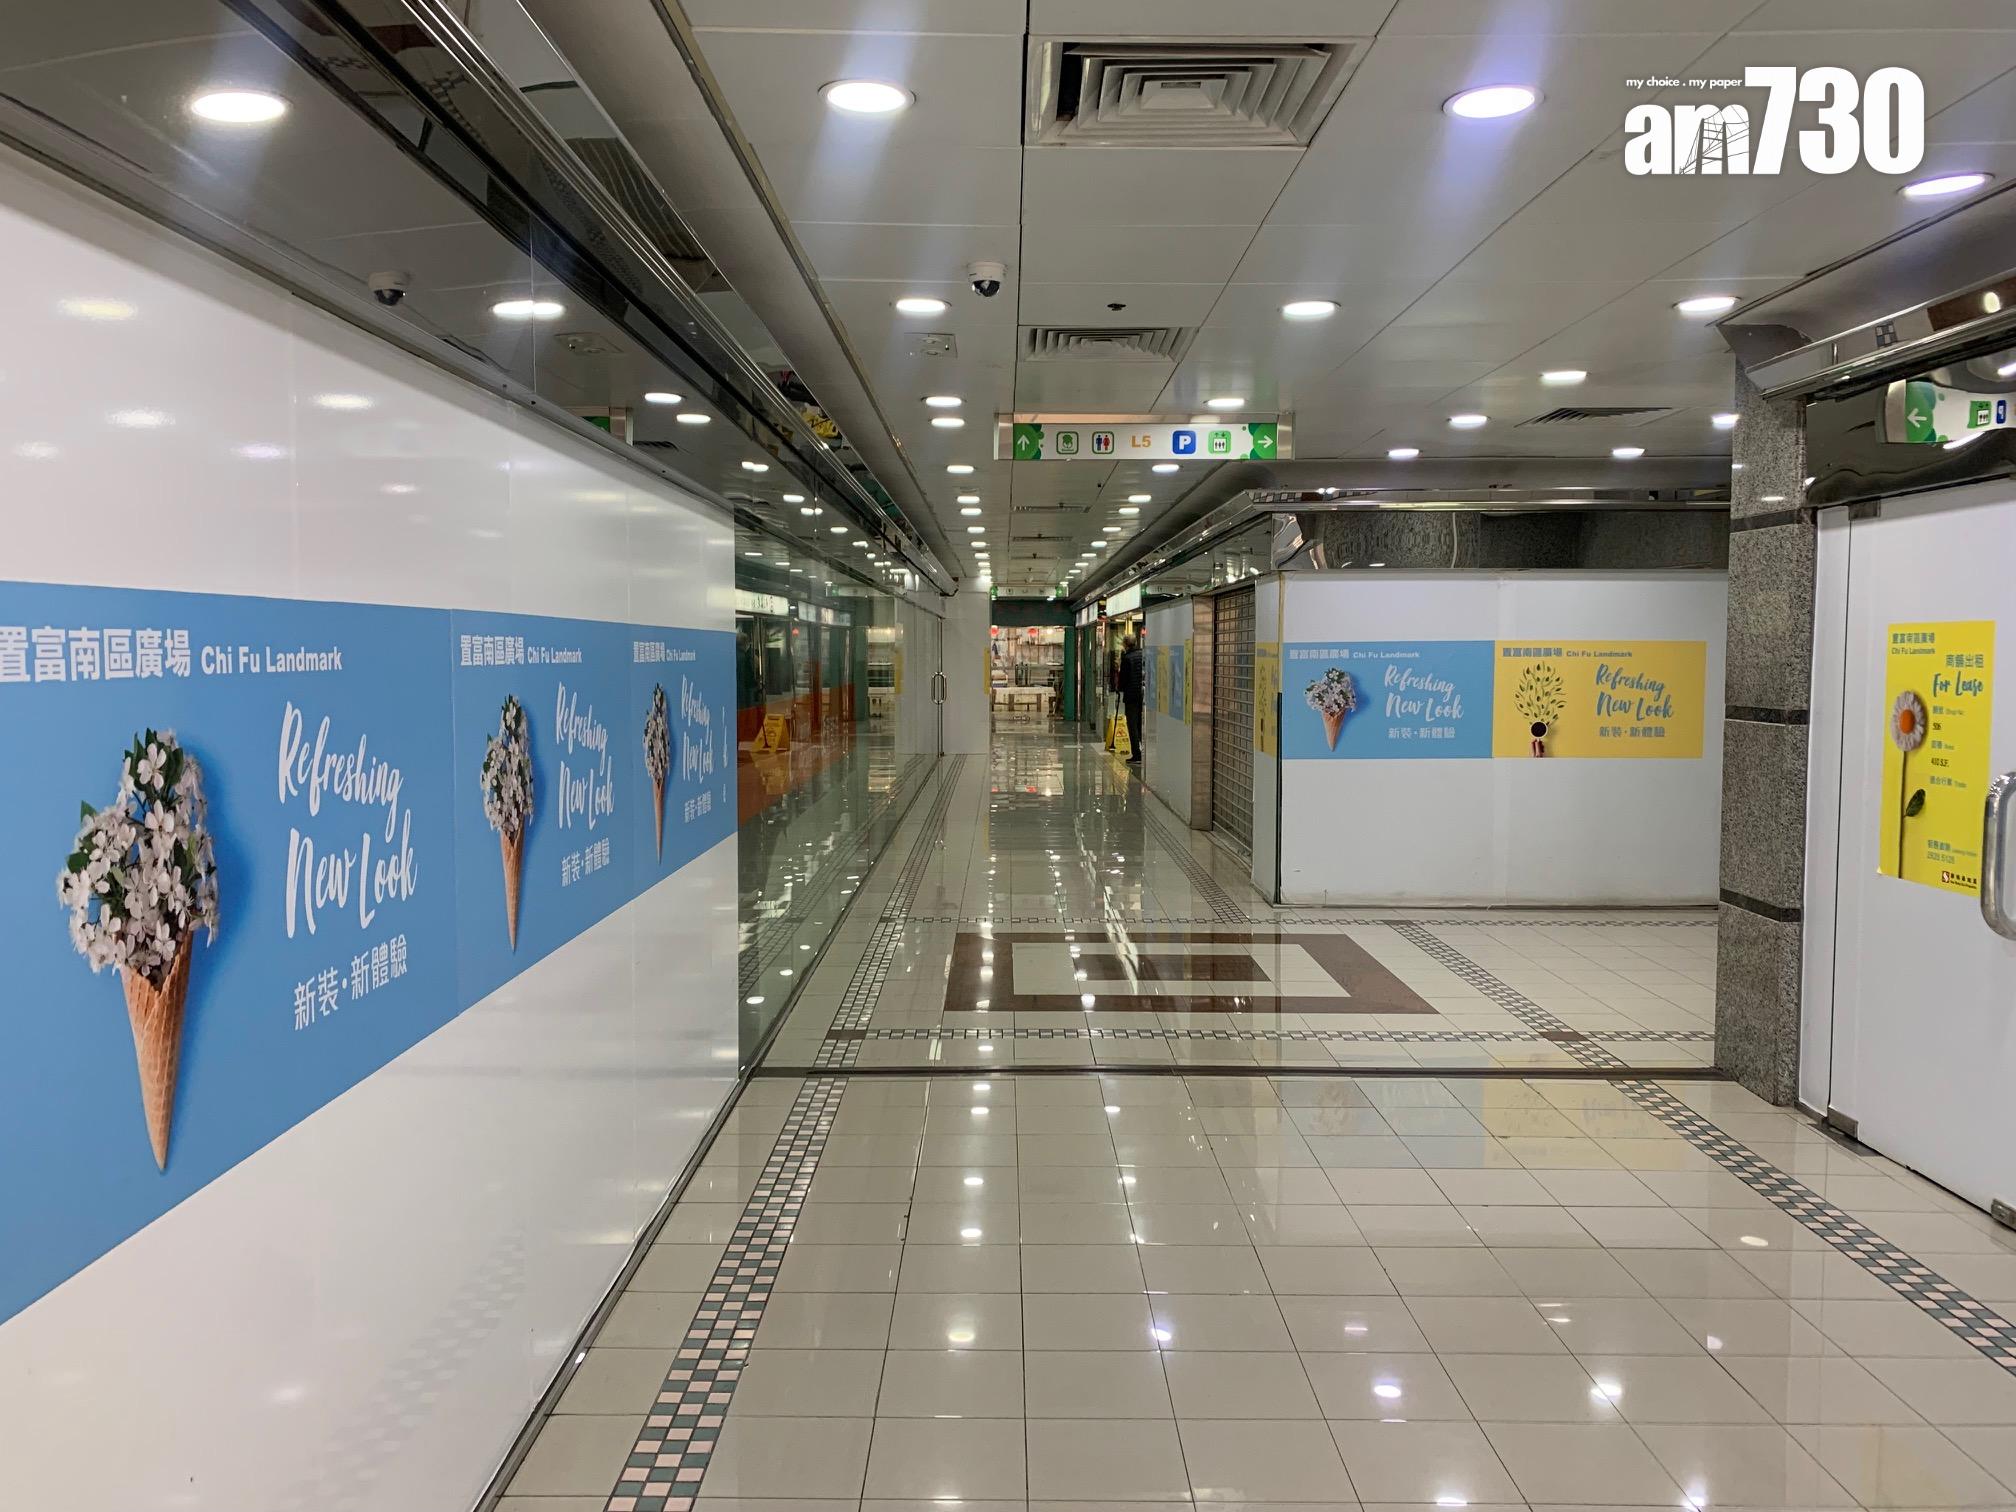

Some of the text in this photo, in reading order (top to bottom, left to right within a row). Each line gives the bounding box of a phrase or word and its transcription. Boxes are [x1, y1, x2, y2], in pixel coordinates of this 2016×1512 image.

[1131, 435, 1191, 450] L5 P
[0, 626, 191, 682] 置富南區廣場
[201, 646, 343, 675] Chi Fu Landmark
[460, 634, 524, 666] 置富南區廣場
[527, 646, 583, 664] Chi Fu Landmark
[1353, 651, 1420, 659] Chi Fu Landmark
[1566, 650, 1633, 658] Chi Fu Landmark
[1384, 663, 1456, 702] Refreshing
[1595, 663, 1666, 702] Refreshing
[1932, 670, 1984, 698] For Lease
[1385, 692, 1465, 722] New Look
[1596, 690, 1675, 721] New Look
[555, 681, 609, 777] Refreshing
[278, 701, 404, 843] Refreshing
[558, 755, 615, 830] New Look
[285, 808, 419, 939] New Look
